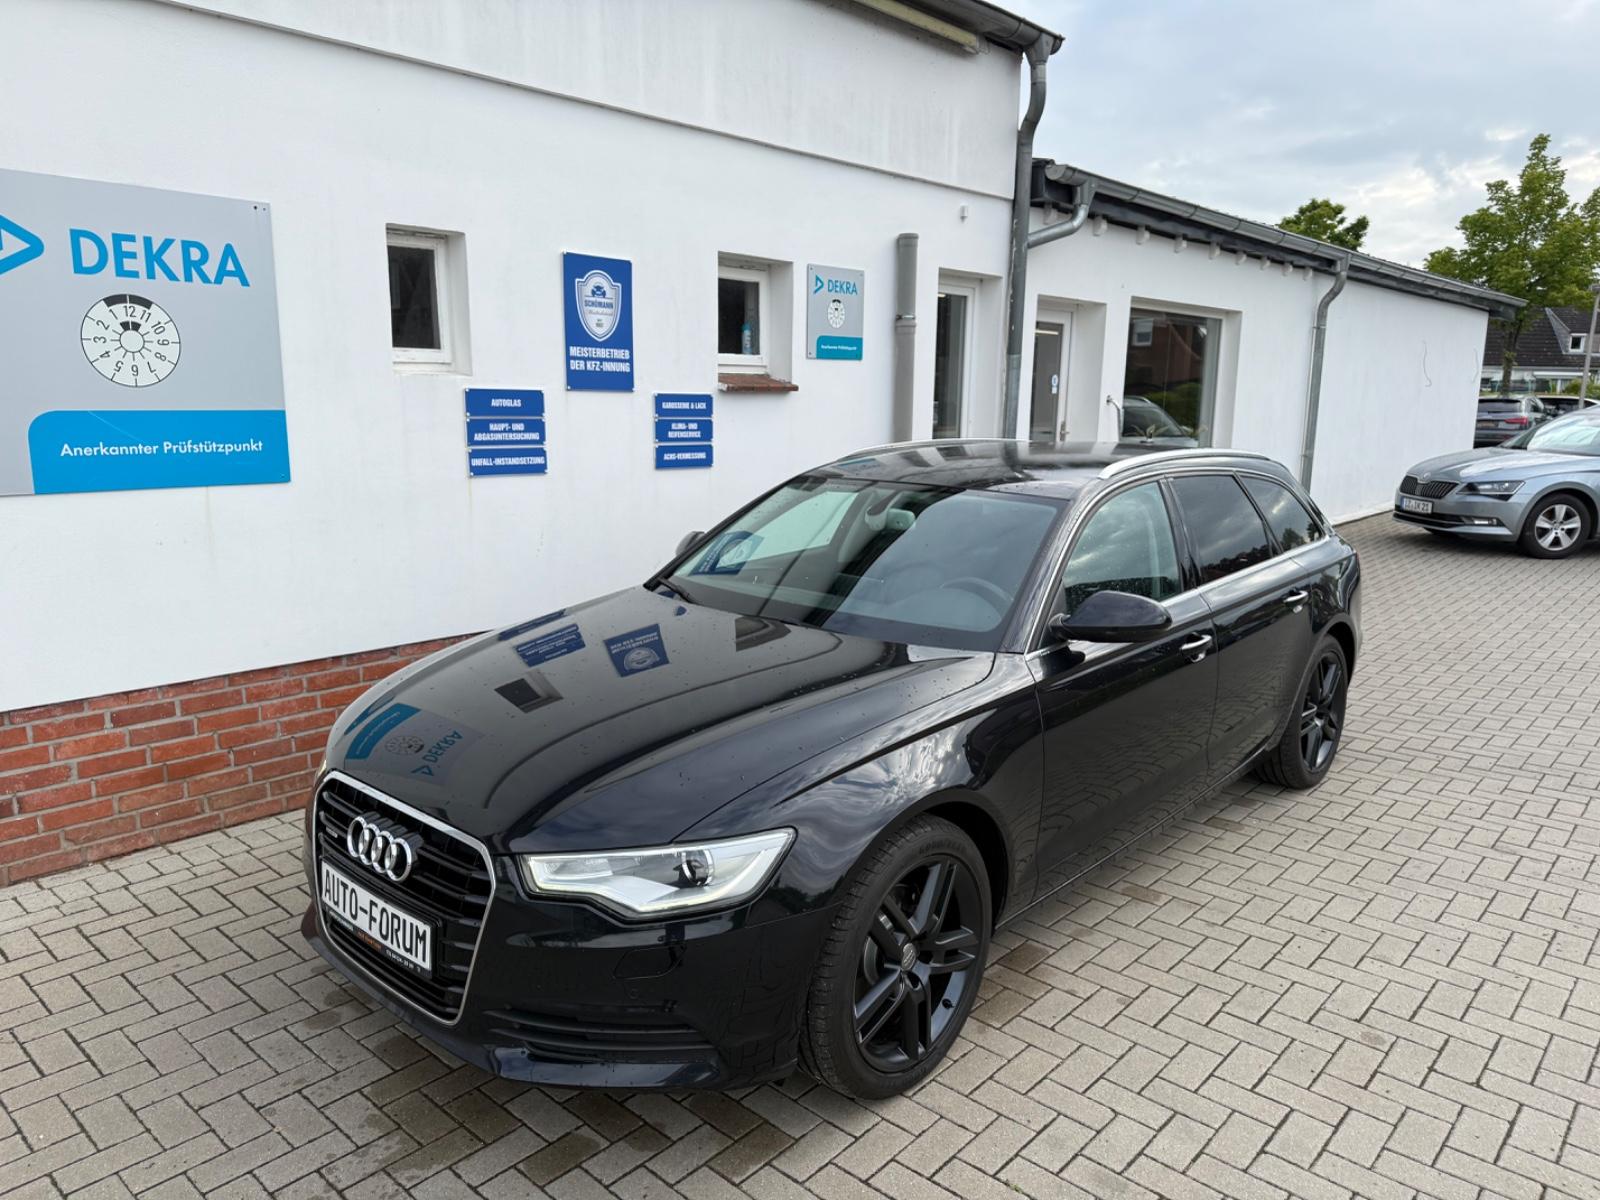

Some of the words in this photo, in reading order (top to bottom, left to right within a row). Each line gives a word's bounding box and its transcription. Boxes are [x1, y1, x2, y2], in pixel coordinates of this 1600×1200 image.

[69, 228, 250, 287] DEKRA
[827, 279, 858, 295] DEKRA
[109, 308, 118, 320] 1
[123, 305, 137, 318] 12
[140, 309, 152, 323] 11
[96, 319, 110, 330] 2
[151, 320, 166, 335] 10
[93, 336, 107, 344] 3
[157, 338, 170, 346] 9
[99, 350, 111, 358] 4
[154, 351, 167, 362] 8
[569, 346, 630, 360] MEISTERBETRIEB
[114, 360, 124, 373] 5
[131, 364, 139, 377] 6
[147, 361, 157, 373] 7
[569, 359, 585, 370] DER
[586, 360, 631, 372] KFZ-INNUNG
[491, 398, 522, 407] AUTOGLAS
[489, 423, 511, 431] HAUPT-
[511, 423, 525, 431] UND
[474, 432, 540, 441] ABGASUNTERSUCHUNG
[60, 442, 159, 457] Anerkannter
[163, 438, 263, 455] Prüfstützpunkt
[471, 456, 545, 466] UNFALL-INSTANDSETZUNG
[324, 869, 428, 964] AUTO-FORUM
